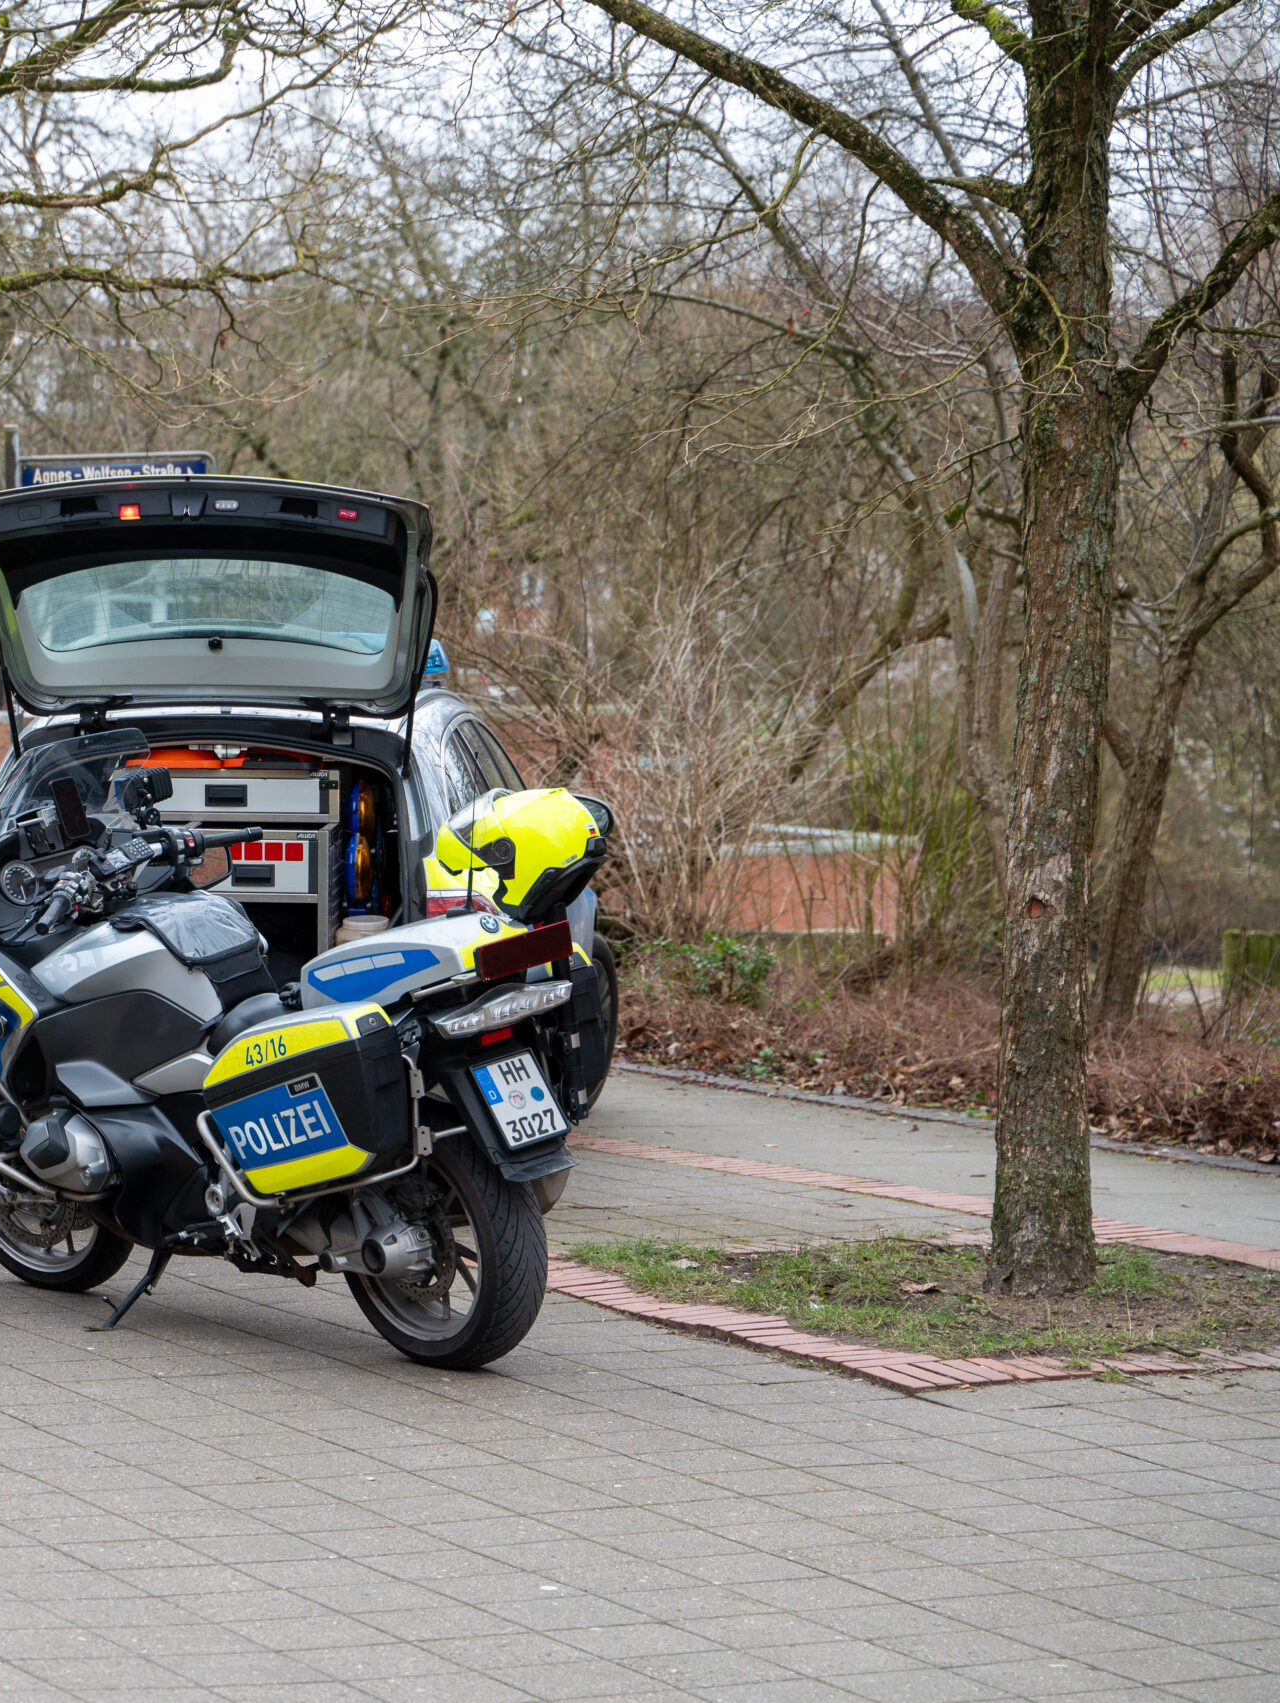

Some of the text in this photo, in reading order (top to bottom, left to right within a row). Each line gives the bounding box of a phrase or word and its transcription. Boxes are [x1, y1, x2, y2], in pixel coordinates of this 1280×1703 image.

[245, 1035, 287, 1067] 43/16
[497, 1058, 531, 1085] HH
[293, 1081, 310, 1092] BMW
[488, 1090, 497, 1100] D
[228, 1100, 332, 1160] POLIZEI
[506, 1108, 557, 1142] 3027
